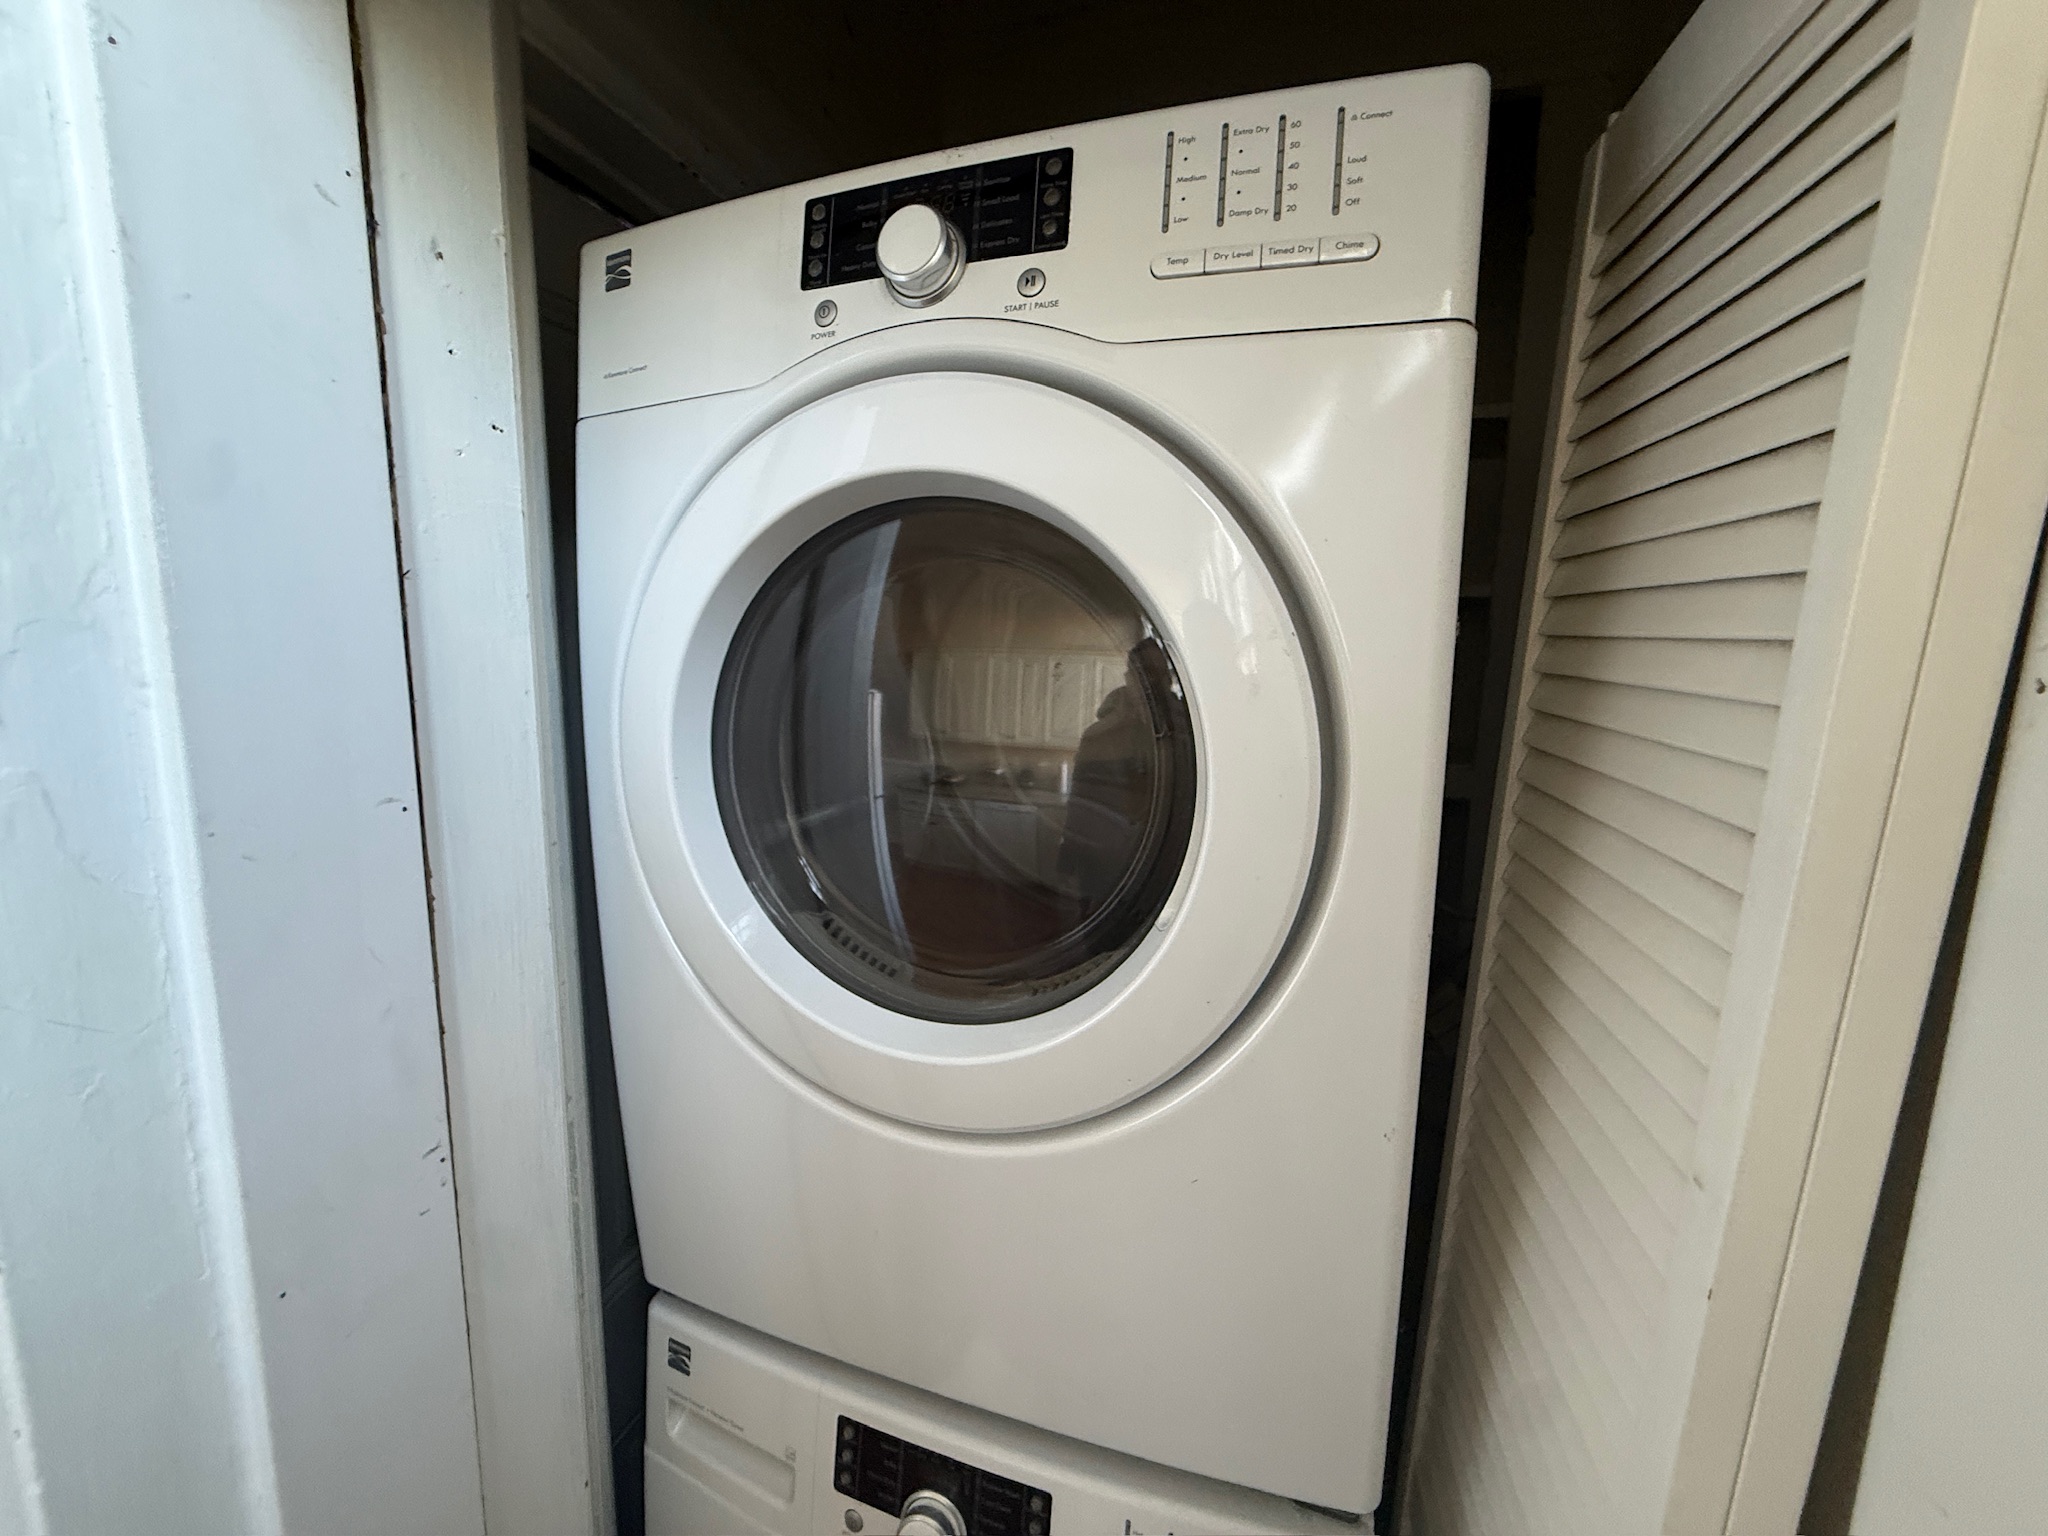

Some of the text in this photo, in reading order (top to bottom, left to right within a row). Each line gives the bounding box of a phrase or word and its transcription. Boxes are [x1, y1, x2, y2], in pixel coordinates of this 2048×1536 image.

[1360, 110, 1394, 121] Connect
[1290, 120, 1302, 129] 60
[1233, 125, 1270, 137] Extra Dry
[1178, 136, 1197, 145] High
[1289, 141, 1301, 150] 50
[1347, 155, 1368, 164] Loud
[1288, 162, 1300, 170] 40
[1231, 166, 1261, 177] Normal
[1176, 173, 1207, 184] Medium
[1346, 176, 1364, 185] Soft
[1286, 183, 1298, 192] 30
[1345, 197, 1361, 206] Off
[1228, 207, 1269, 218] Damp Dry
[1286, 204, 1298, 213] 20
[1173, 215, 1189, 224] Low
[1268, 244, 1314, 256] Timed Dry
[1335, 240, 1365, 250] Chime
[1213, 249, 1254, 262] Dry Level
[1166, 256, 1189, 267] Temp
[1003, 299, 1060, 314] START PAUSE
[810, 330, 836, 341] POWER
